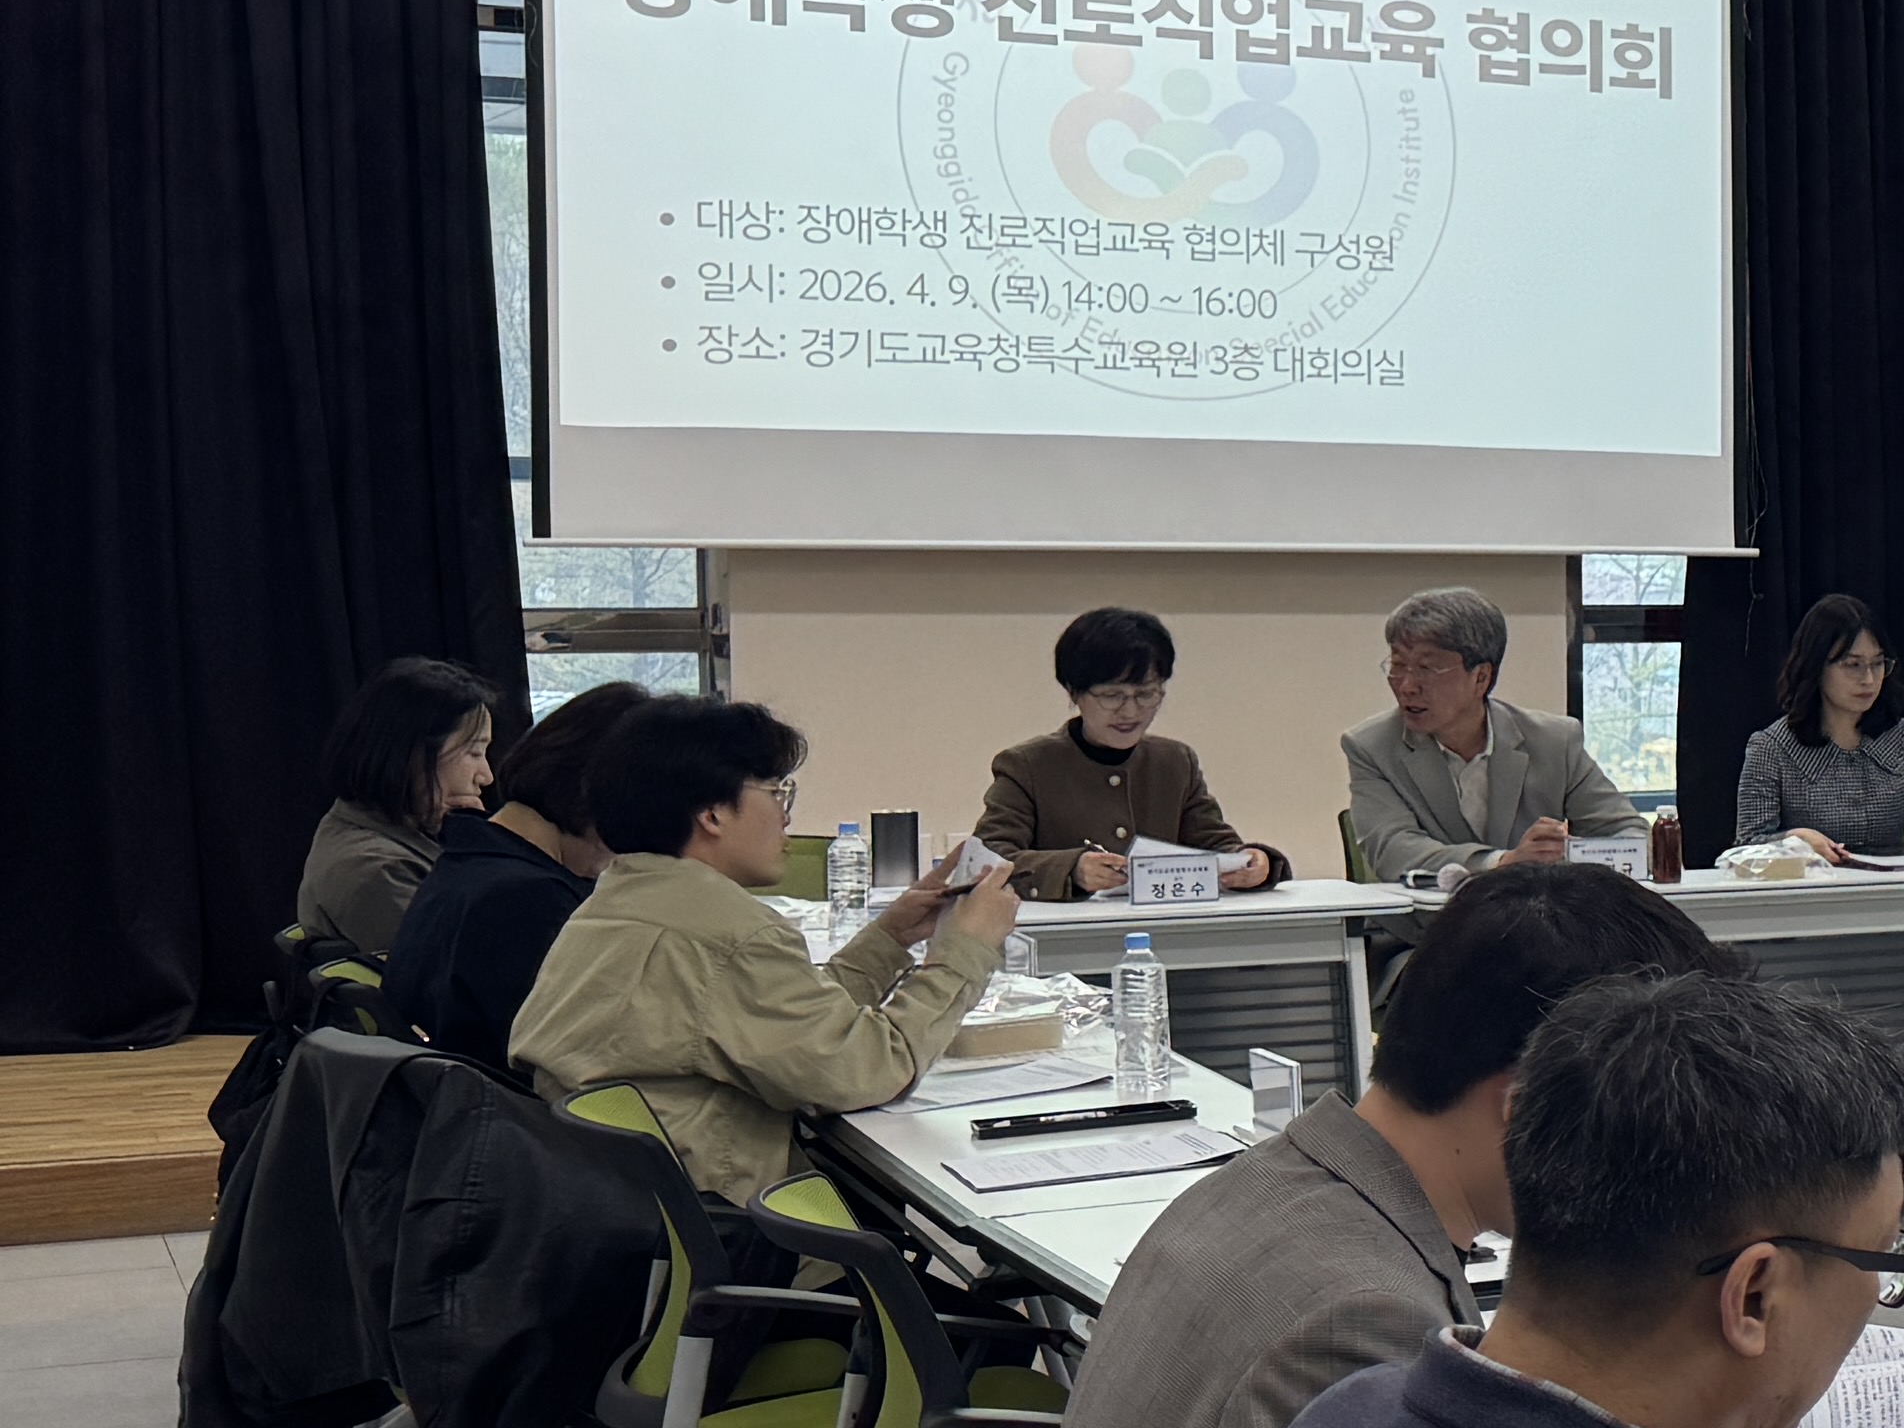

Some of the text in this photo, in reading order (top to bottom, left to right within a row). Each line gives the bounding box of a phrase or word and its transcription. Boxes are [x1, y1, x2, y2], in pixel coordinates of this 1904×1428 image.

[1466, 7, 1673, 100] 협의회
[1392, 88, 1421, 205] Institute
[697, 198, 1395, 272] 대상: 장애학생 진로직업교육 협의체 구성원
[697, 261, 786, 303] 일시:
[798, 268, 896, 305] 2026.
[906, 273, 936, 307] 4.
[948, 274, 978, 309] 9.
[991, 273, 1050, 314] (목)
[1062, 280, 1149, 314] 14:00
[1193, 285, 1278, 320] 16:00
[697, 324, 787, 365] 장소:
[800, 327, 1199, 379] 경기도교육청특수교육원
[1209, 343, 1264, 382] 3층
[1273, 346, 1406, 387] 대회의실
